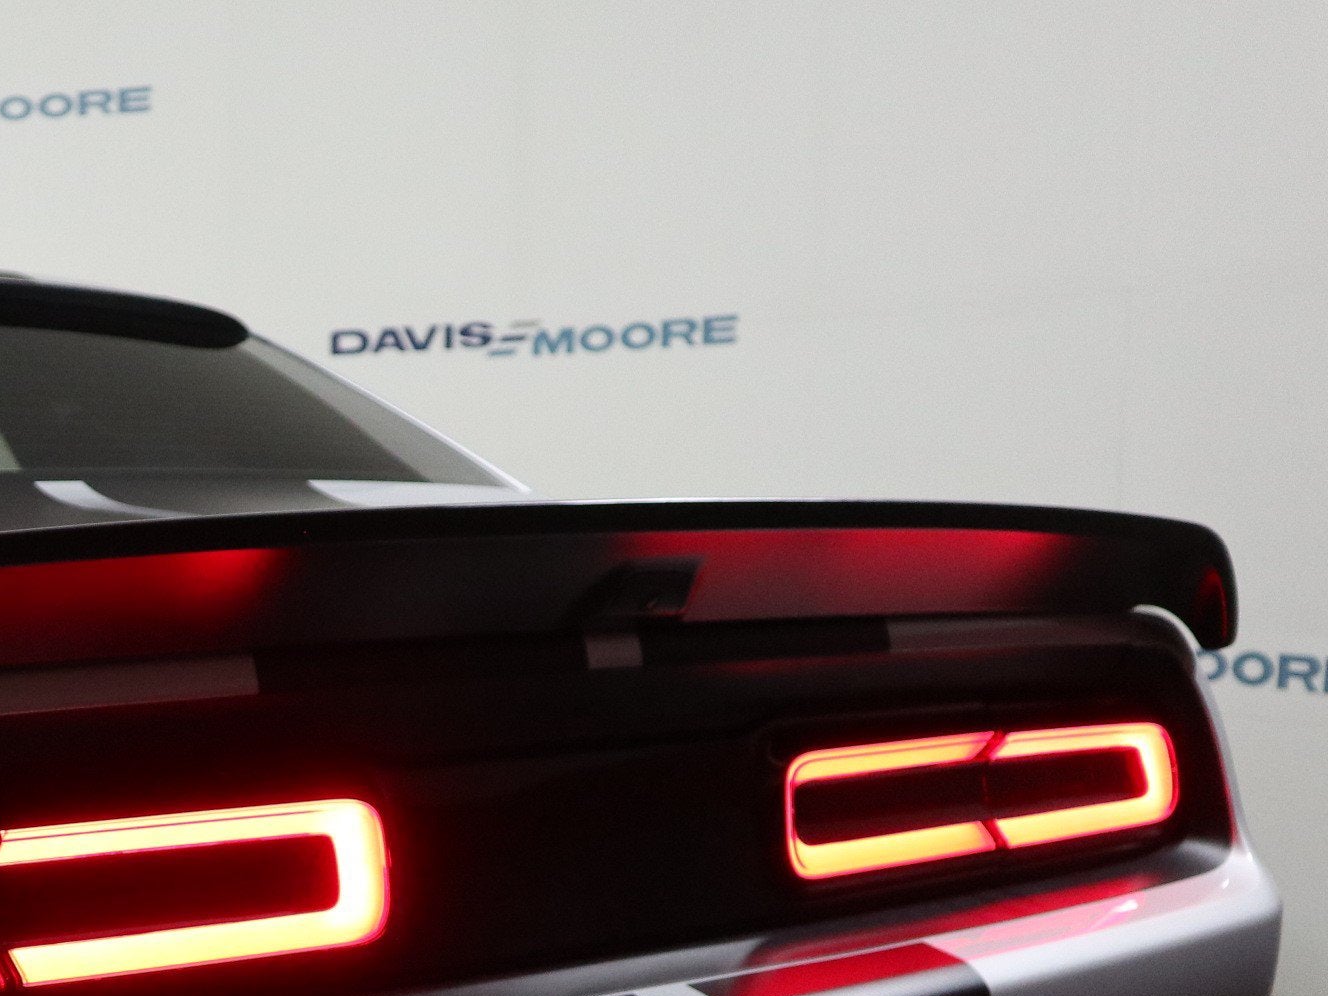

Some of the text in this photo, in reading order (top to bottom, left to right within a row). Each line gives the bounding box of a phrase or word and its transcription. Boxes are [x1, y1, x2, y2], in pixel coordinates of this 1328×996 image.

[331, 315, 739, 356] DAVIS MOORE
[1196, 648, 1328, 693] OOR
